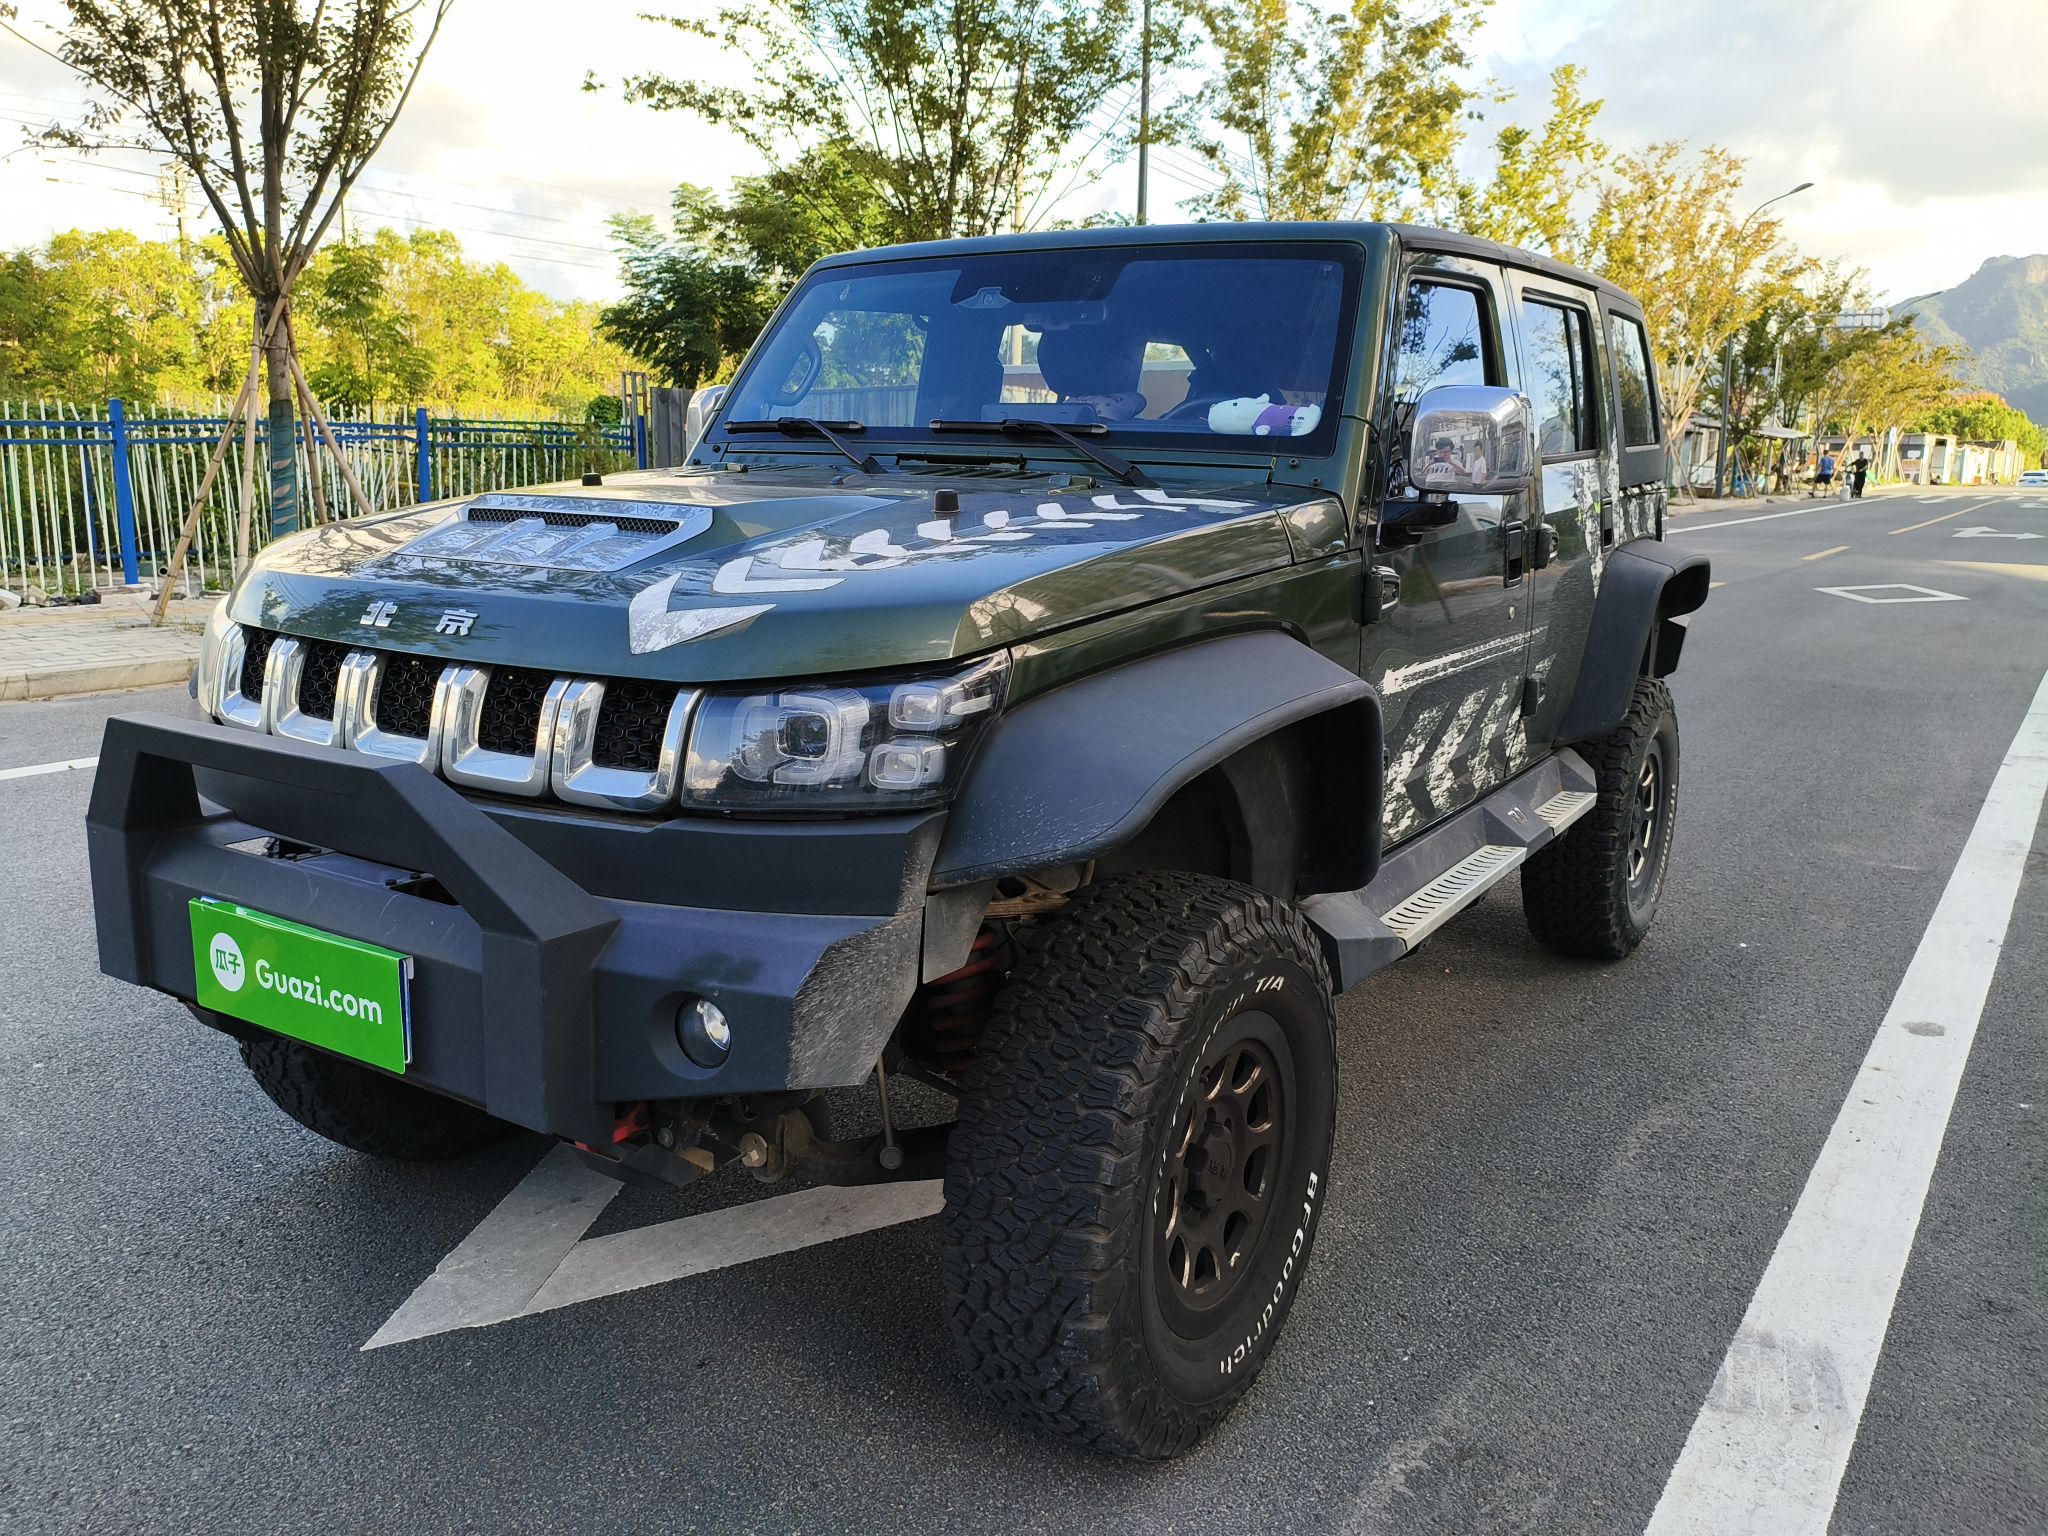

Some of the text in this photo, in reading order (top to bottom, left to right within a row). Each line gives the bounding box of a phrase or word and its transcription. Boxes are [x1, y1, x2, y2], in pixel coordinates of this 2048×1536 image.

[360, 600, 480, 636] 北京
[215, 948, 241, 974] 瓜子
[255, 958, 383, 1025] Guazi.com
[1254, 975, 1285, 994] T/A
